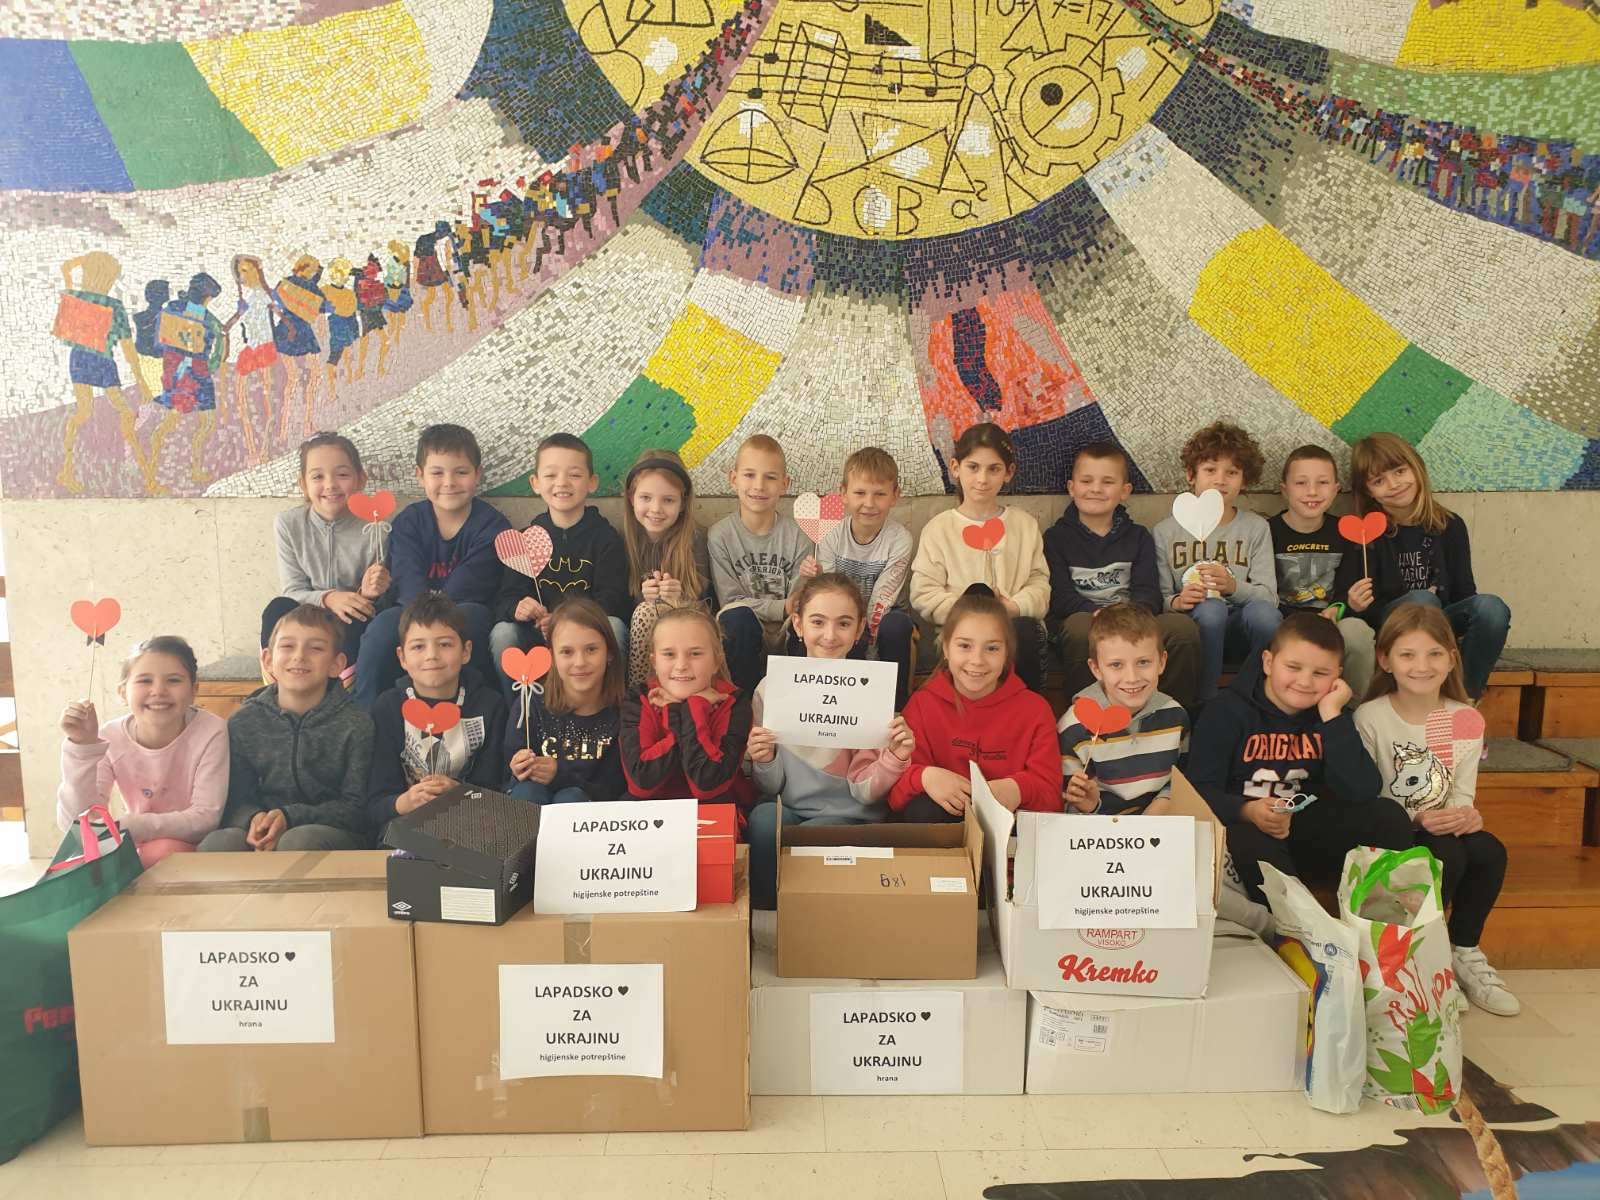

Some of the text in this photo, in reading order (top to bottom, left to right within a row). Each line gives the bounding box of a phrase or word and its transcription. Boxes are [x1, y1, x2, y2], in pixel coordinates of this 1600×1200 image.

[1286, 543, 1330, 552] CONCRETE
[1173, 540, 1249, 570] GOAL
[793, 673, 857, 687] LAPADSKO
[822, 694, 838, 705] ZA
[799, 712, 858, 726] UKRAJINU
[817, 730, 837, 738] hrana
[572, 819, 649, 833] LAPADSKO
[607, 842, 627, 856] ZA
[1069, 837, 1146, 851] LAPADSKO
[579, 866, 653, 881] UKRAJINU
[1105, 861, 1126, 874] ZA
[573, 887, 659, 900] higijenske potrepštine
[1080, 885, 1153, 899] UKRAJINU
[1074, 905, 1160, 918] higijenske potrepštine
[1086, 928, 1138, 940] RAMPART
[199, 951, 280, 964] LAPADSKO
[1057, 953, 1160, 984] Kremko
[239, 975, 259, 988] ZA
[534, 985, 614, 999] LAPADSKO
[211, 999, 288, 1012] UKRAJINU
[572, 1009, 592, 1022] ZA
[843, 1011, 917, 1024] LAPADSKO
[238, 1020, 263, 1028] hrana
[545, 1031, 620, 1045] UKRAJINU
[878, 1034, 897, 1046] ZA
[539, 1051, 627, 1064] higijenske potrepštine
[852, 1055, 922, 1068] UKRAJINU
[876, 1073, 899, 1083] hrana
